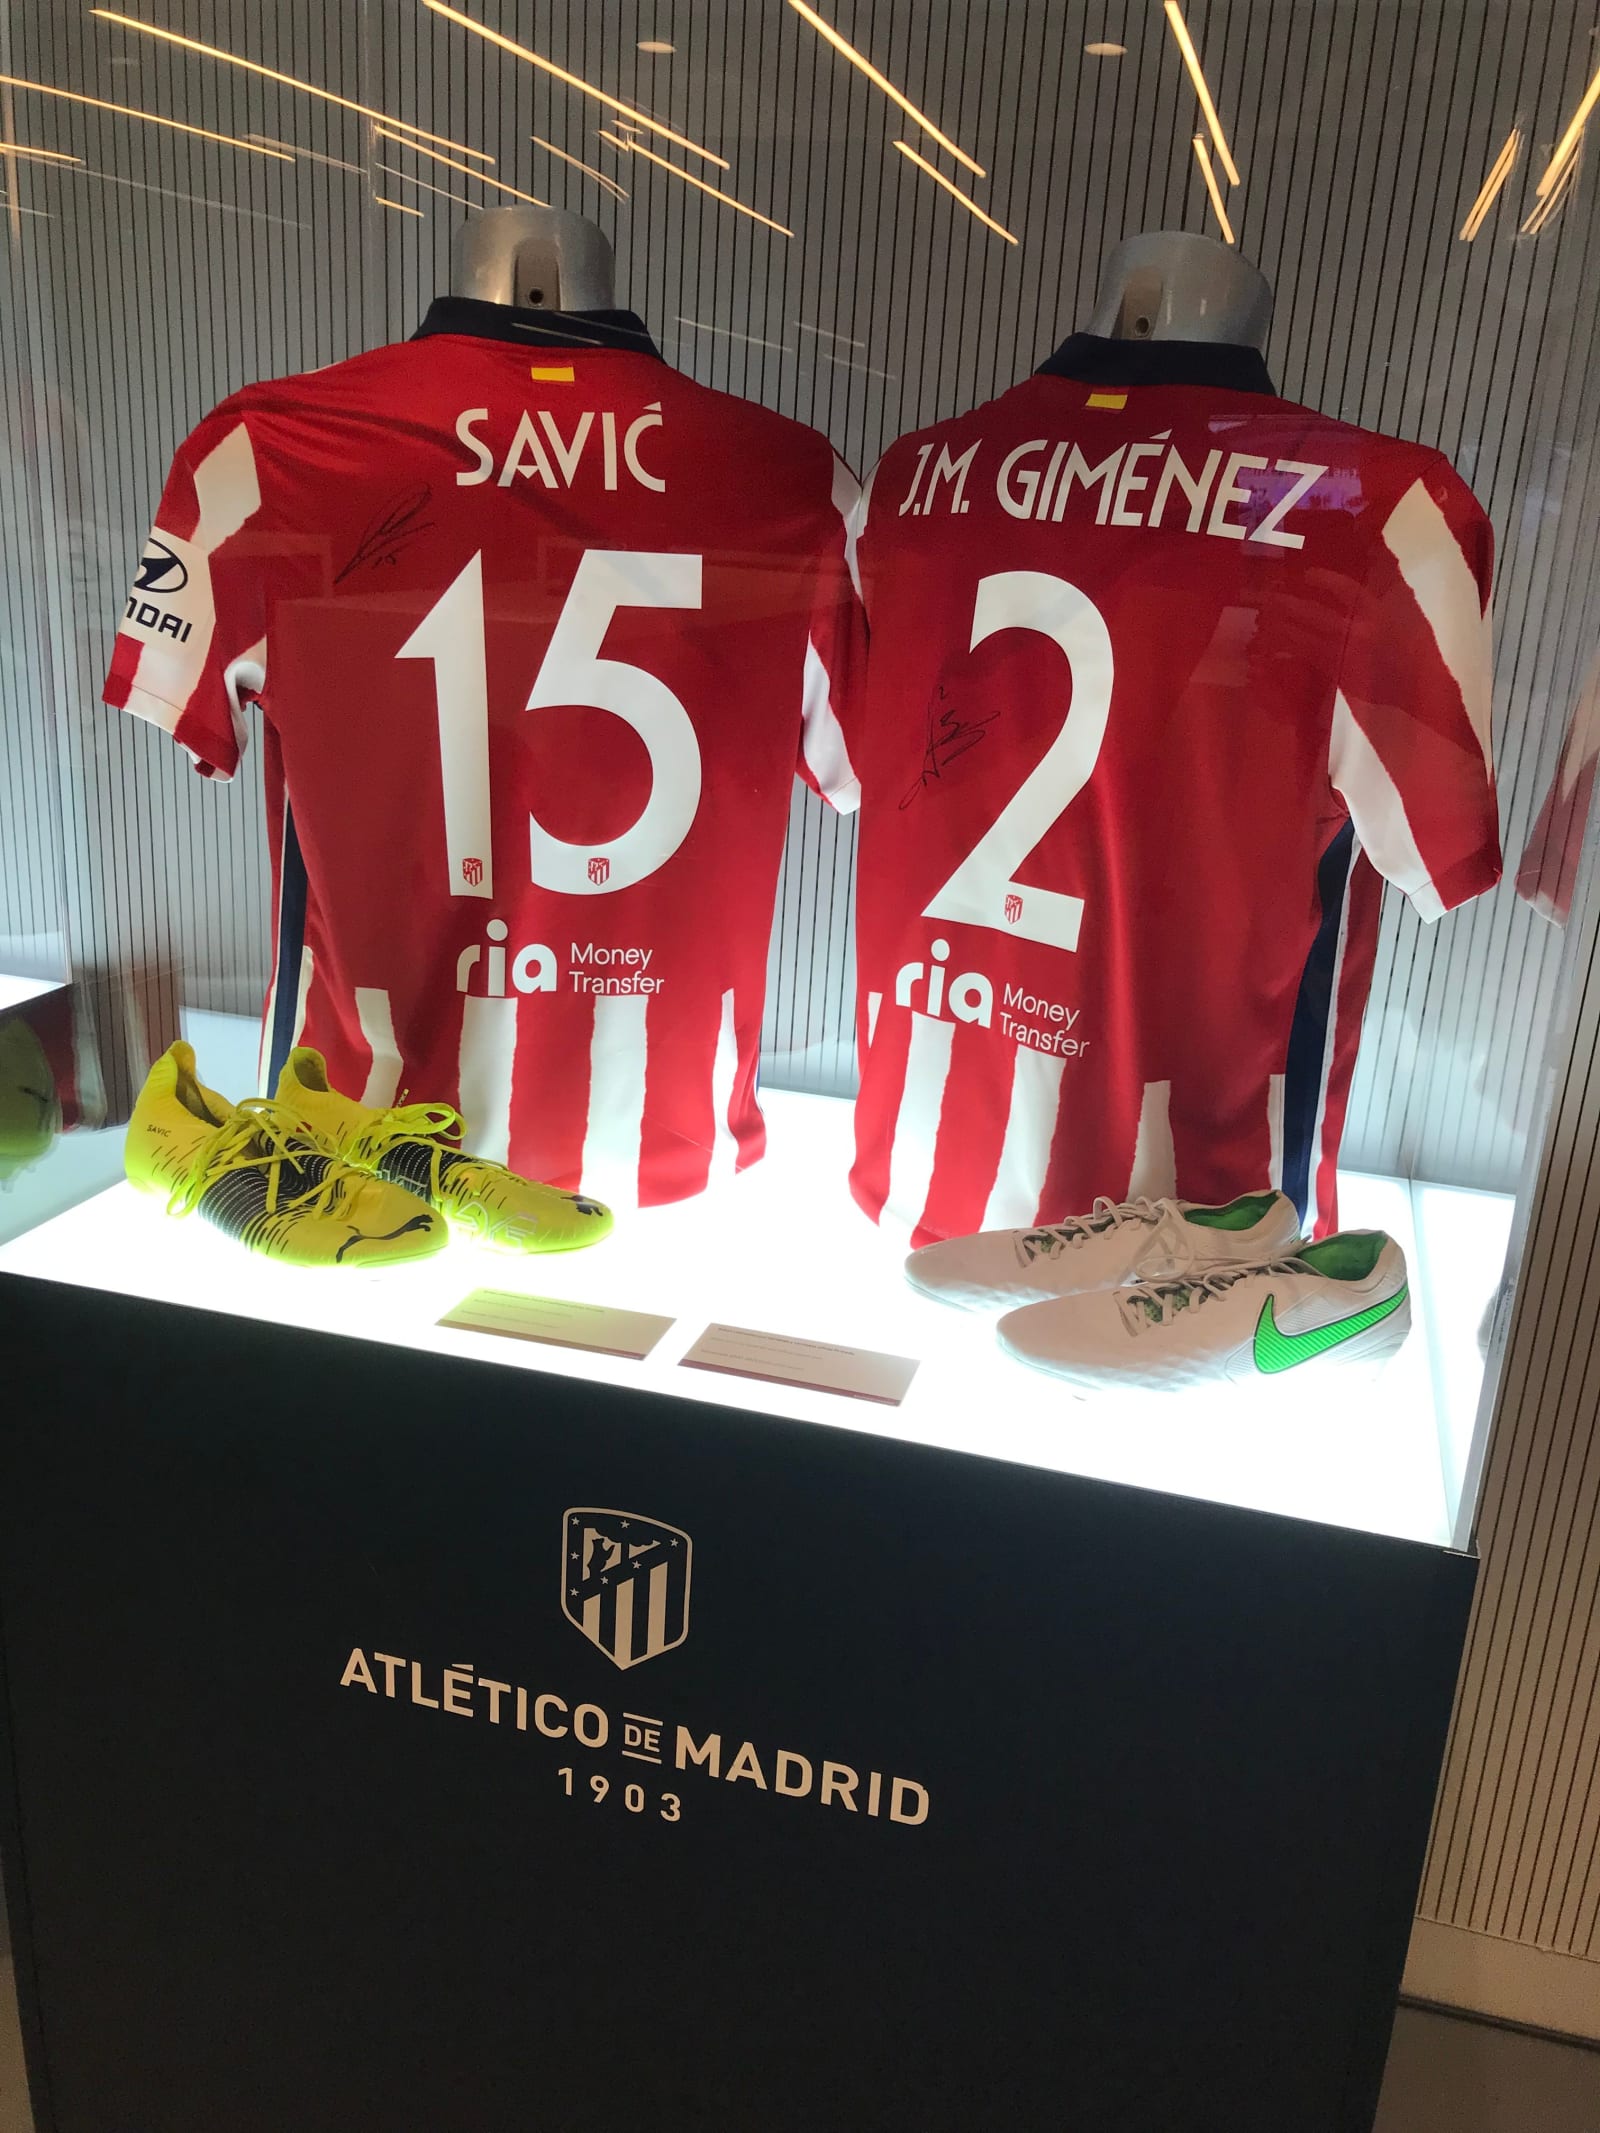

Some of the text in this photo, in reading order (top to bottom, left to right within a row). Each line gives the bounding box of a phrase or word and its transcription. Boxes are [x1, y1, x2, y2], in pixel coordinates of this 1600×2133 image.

[456, 402, 665, 492] SAVIĆ
[899, 430, 1328, 549] J.M. GIMÉNEZ
[395, 549, 702, 899] 15
[921, 571, 1114, 952] 2
[456, 918, 557, 996] ria
[569, 969, 664, 995] Transfer
[570, 942, 652, 970] Money
[896, 938, 993, 1029] ria
[1000, 1012, 1091, 1058] Transfer
[1003, 983, 1080, 1031] Money
[340, 1647, 930, 1826] ATLÉTICO DE MADRID
[558, 1767, 681, 1822] 1903
